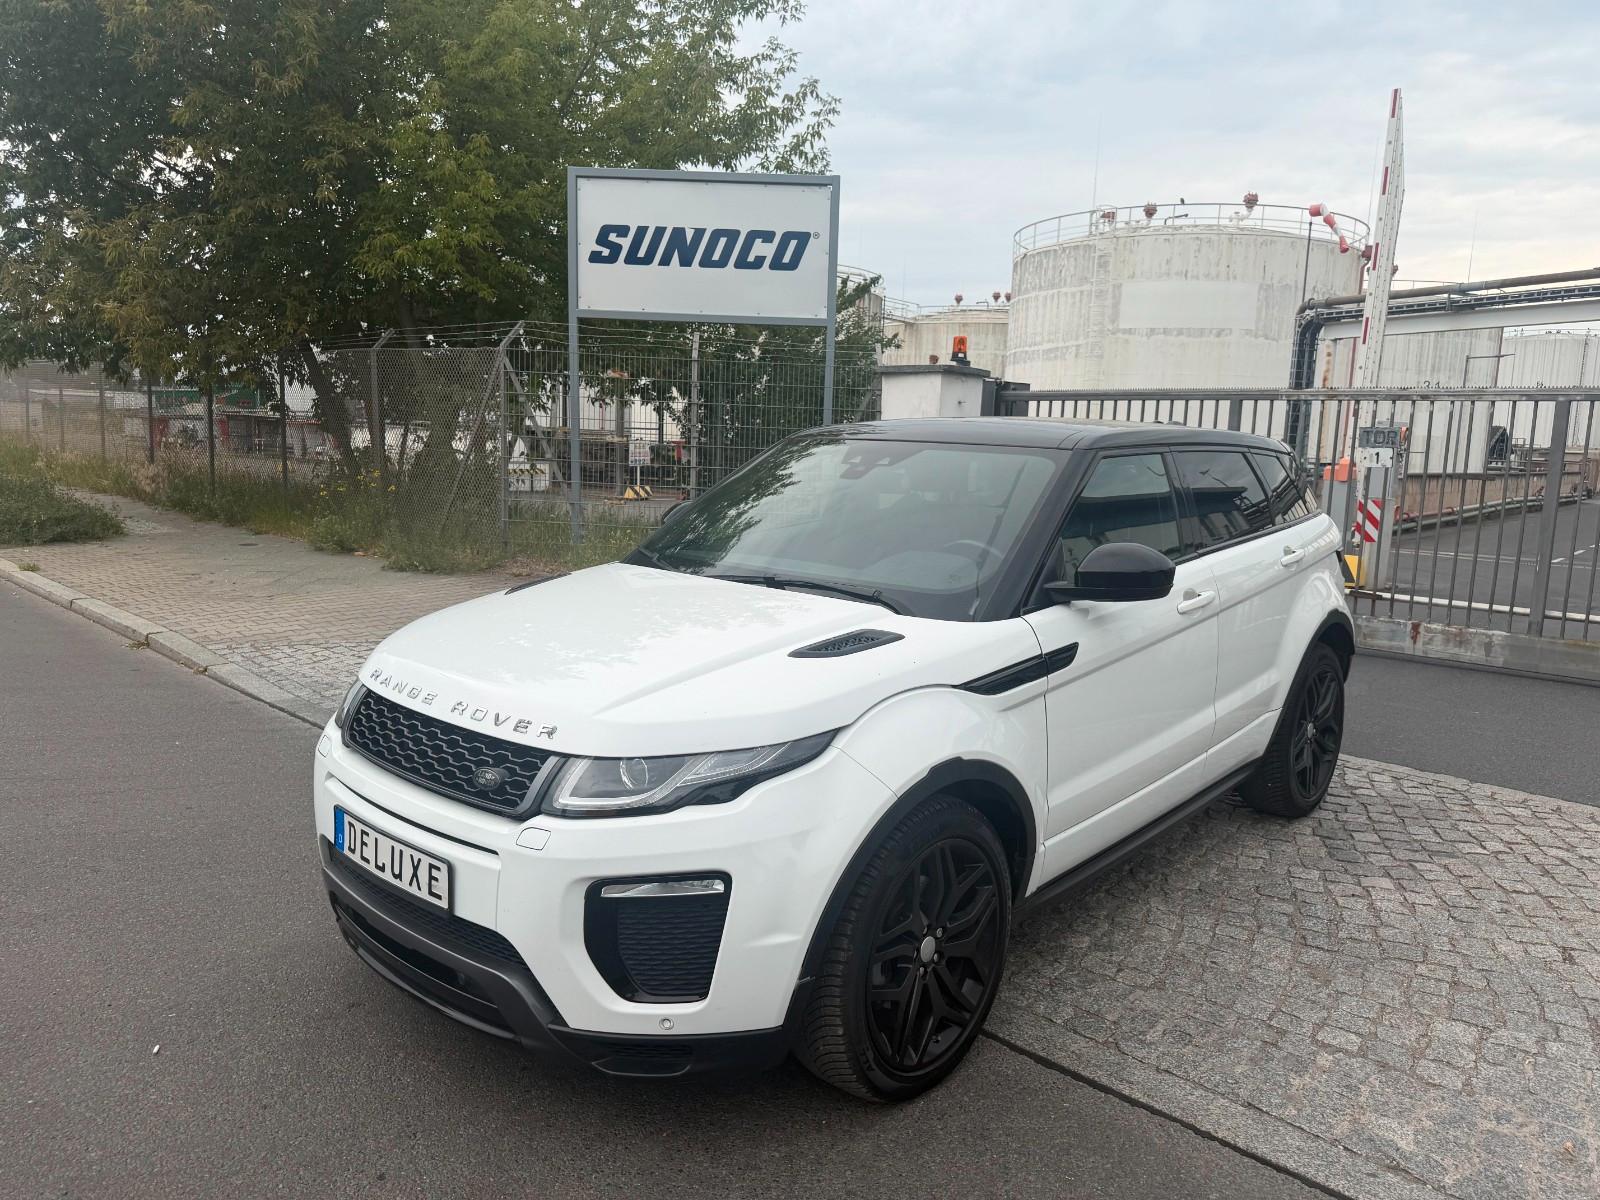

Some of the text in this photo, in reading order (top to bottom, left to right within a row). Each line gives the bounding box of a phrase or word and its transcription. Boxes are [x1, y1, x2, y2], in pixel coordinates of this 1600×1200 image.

[1363, 430, 1398, 446] TOR
[1374, 451, 1380, 465] 1
[370, 667, 558, 740] RANGE ROVER
[338, 820, 443, 901] D DELUXE
